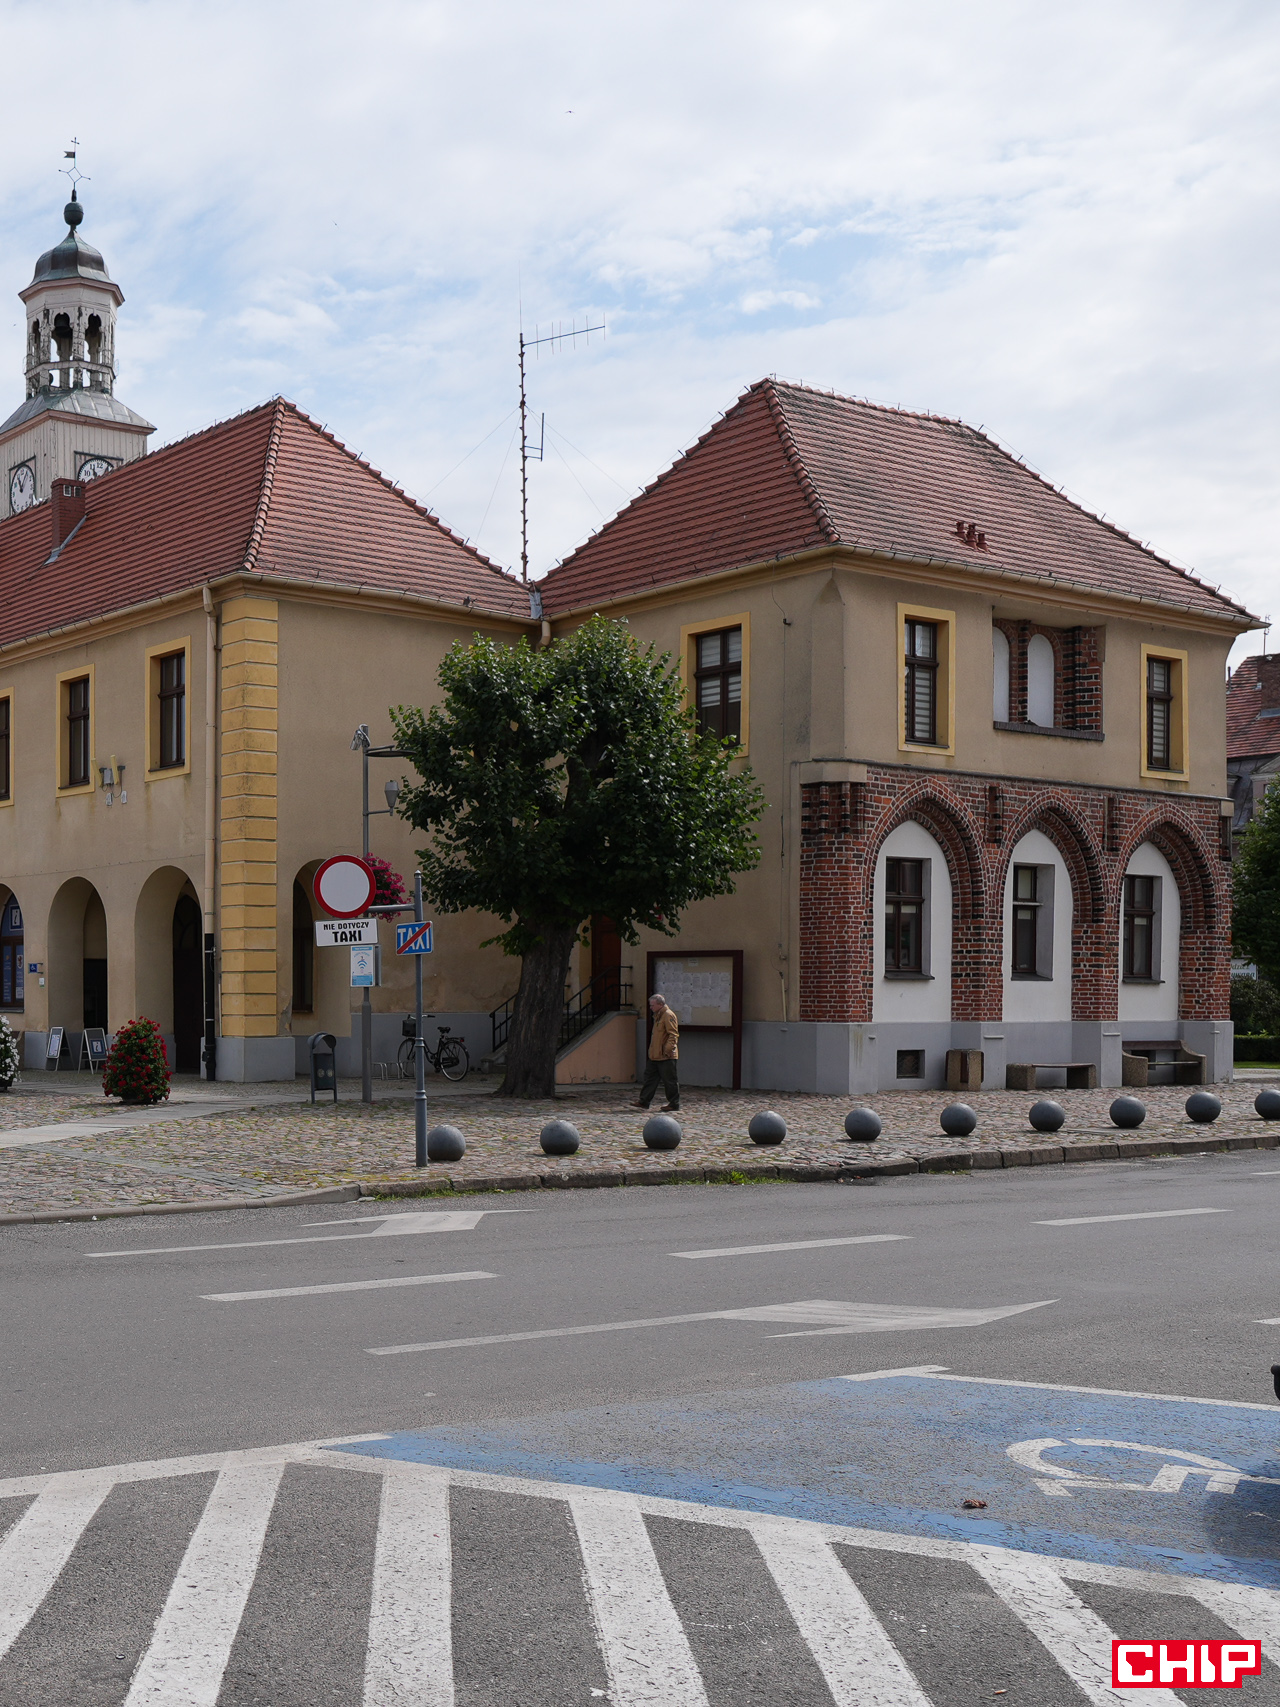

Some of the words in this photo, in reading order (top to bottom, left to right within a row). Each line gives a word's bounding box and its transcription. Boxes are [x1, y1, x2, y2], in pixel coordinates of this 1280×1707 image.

[338, 921, 370, 930] DOTYCZY
[332, 930, 362, 943] TAXI
[397, 925, 430, 950] TAXI
